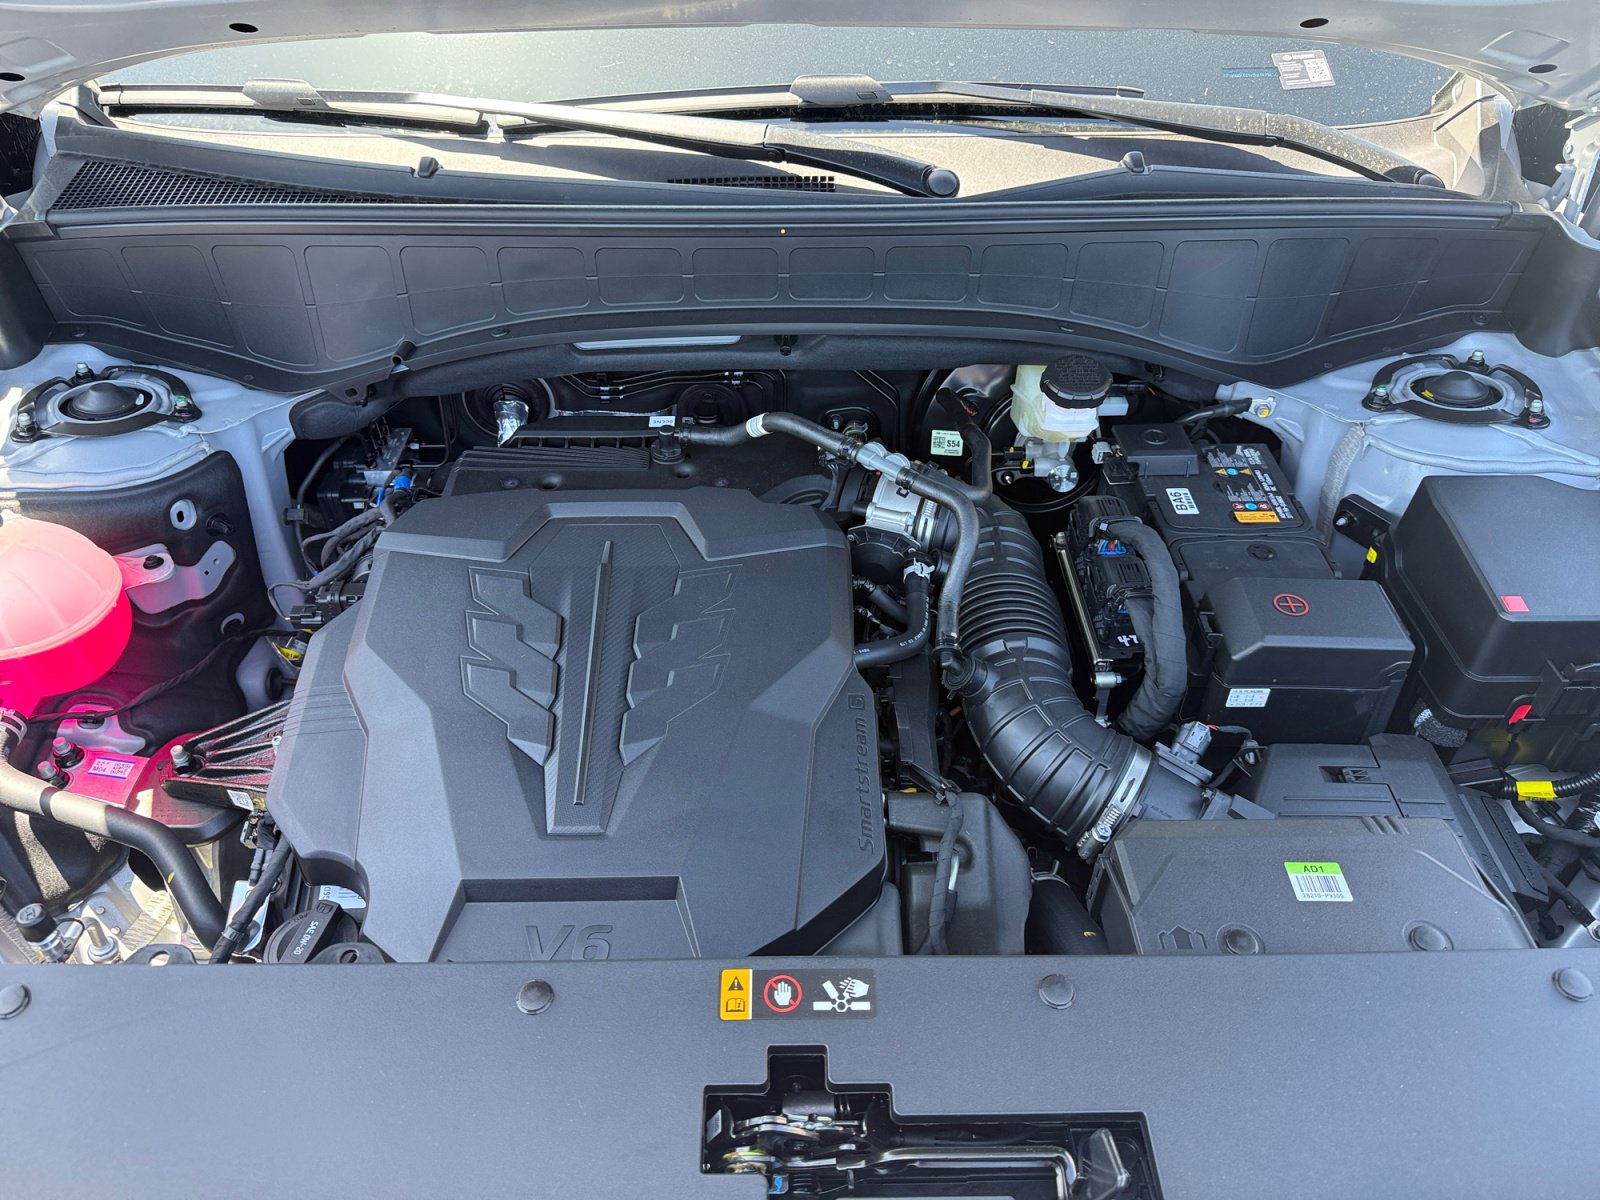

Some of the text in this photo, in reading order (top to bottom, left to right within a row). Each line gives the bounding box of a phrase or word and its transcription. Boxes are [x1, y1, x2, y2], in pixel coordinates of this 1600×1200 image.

[946, 439, 961, 448] S54
[1170, 492, 1188, 510] BA6
[1117, 634, 1139, 647] 47
[856, 715, 877, 855] Smartstream
[1303, 865, 1325, 873] AD1
[293, 920, 319, 955] SAE 0W-20
[524, 924, 613, 961] V6
